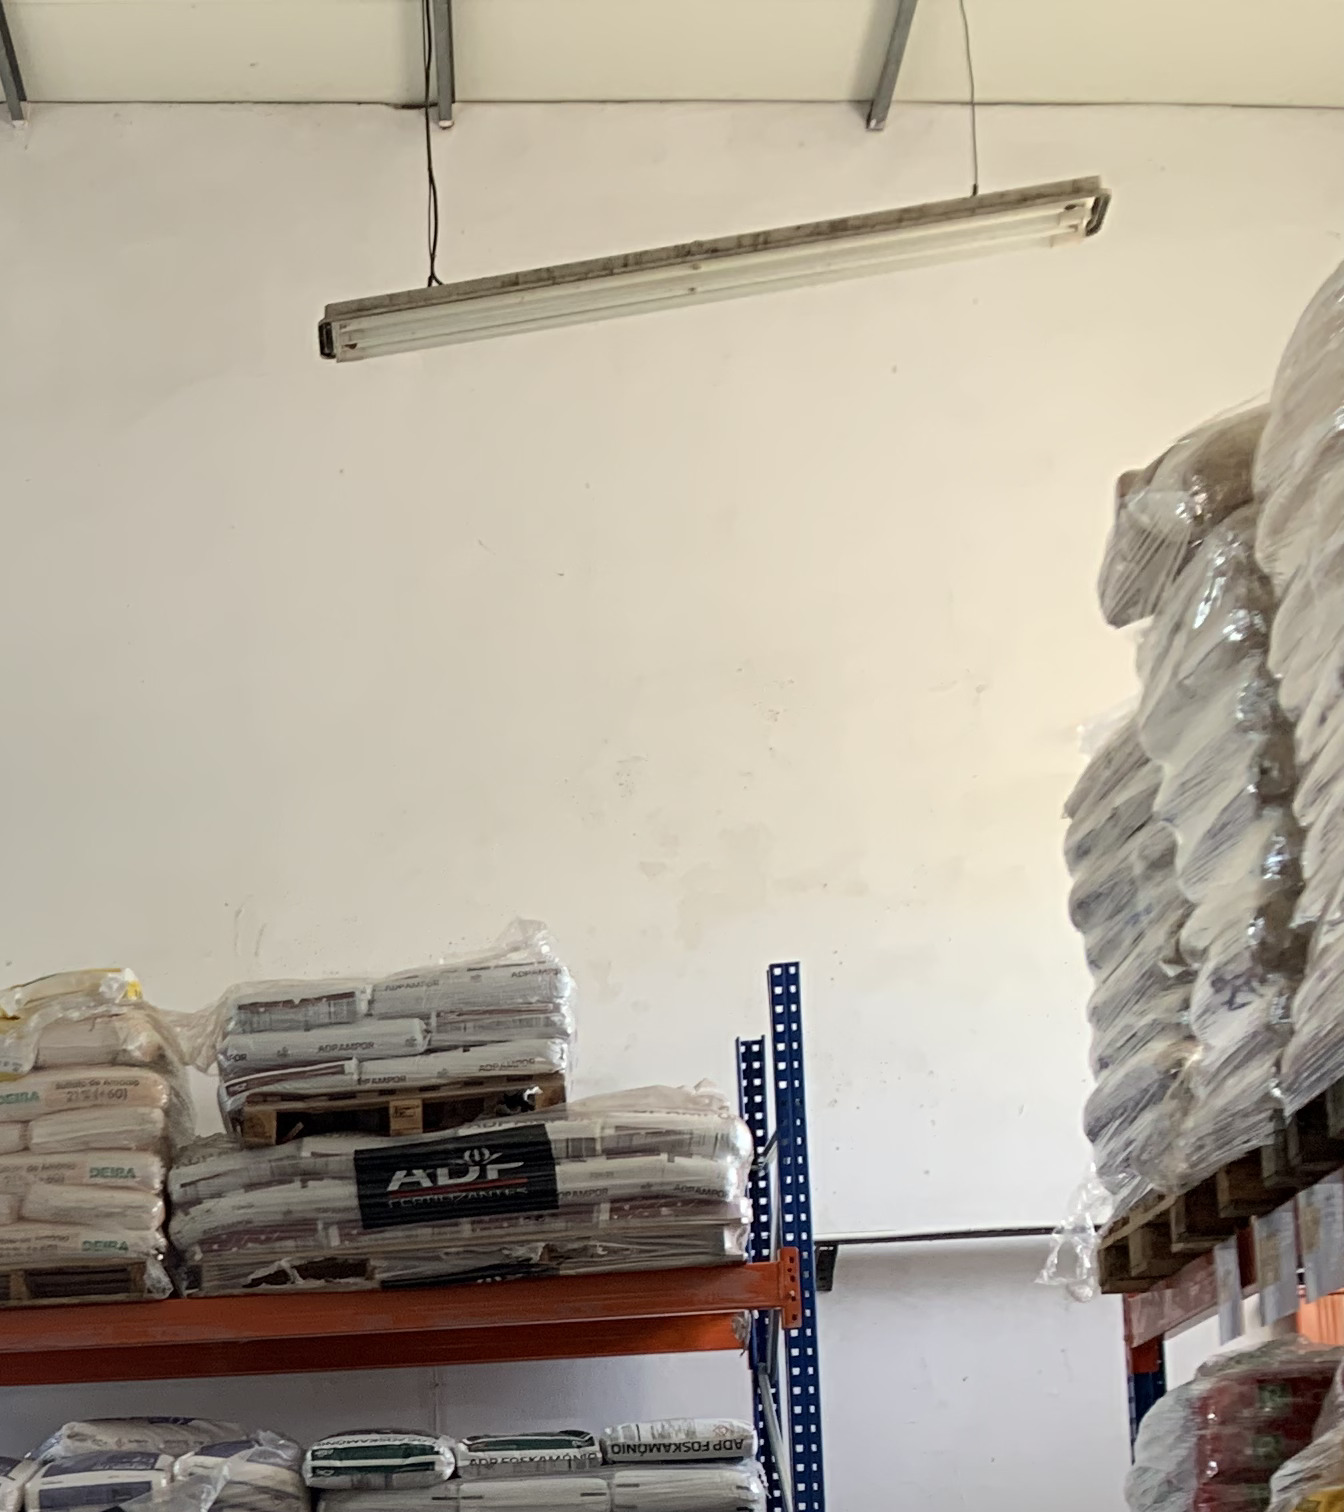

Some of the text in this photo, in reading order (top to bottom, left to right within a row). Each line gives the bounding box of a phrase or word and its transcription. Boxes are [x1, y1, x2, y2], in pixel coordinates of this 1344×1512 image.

[65, 1089, 91, 1103] 21%
[89, 1165, 137, 1180] DEIBA
[80, 1239, 130, 1253] DEIBA
[611, 1438, 744, 1456] ADP FOSKAMÓNIO
